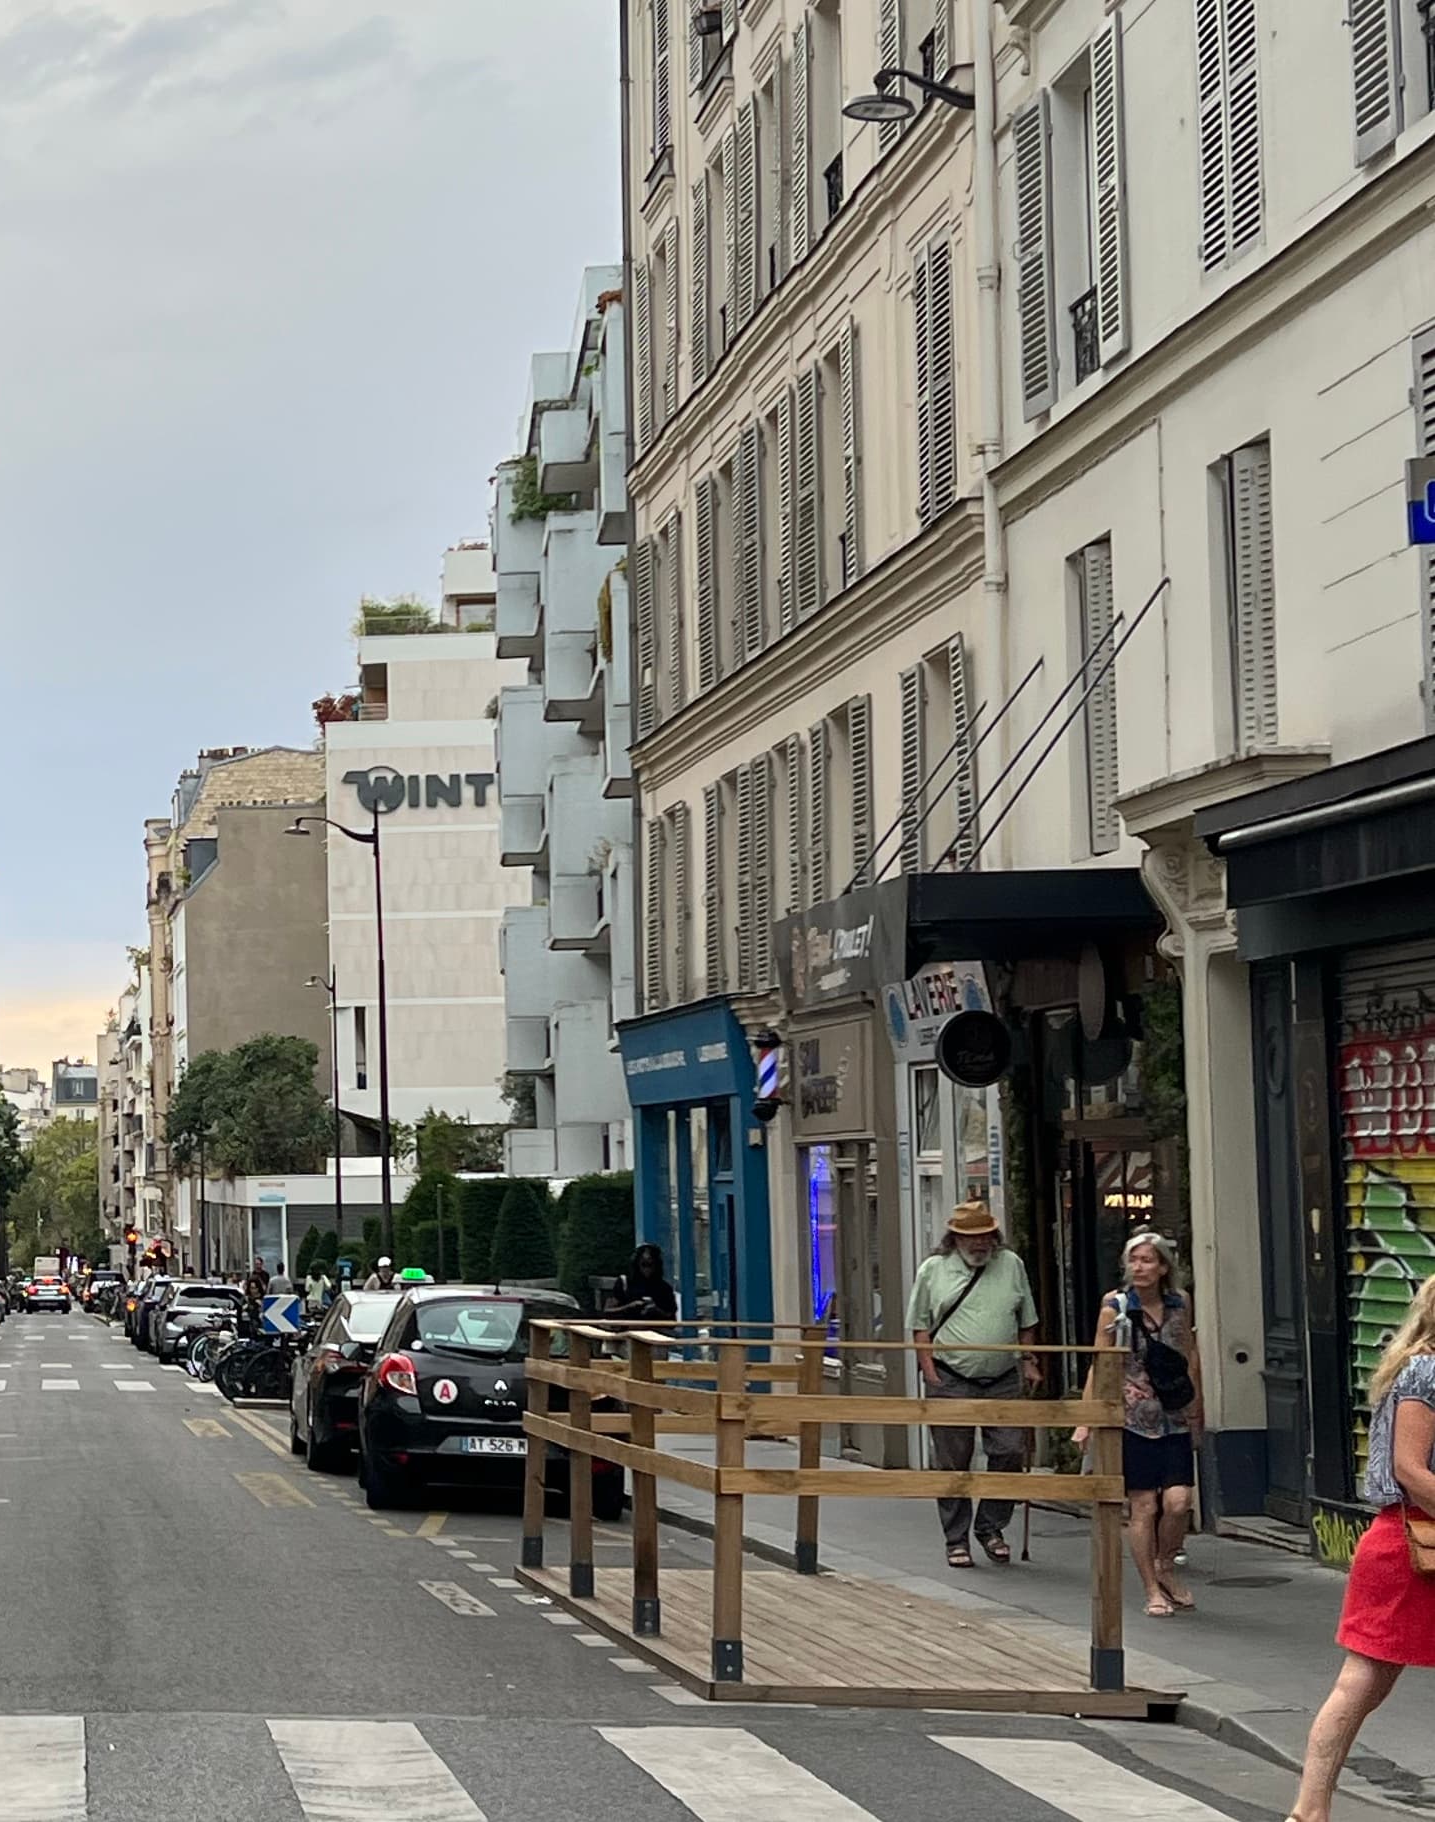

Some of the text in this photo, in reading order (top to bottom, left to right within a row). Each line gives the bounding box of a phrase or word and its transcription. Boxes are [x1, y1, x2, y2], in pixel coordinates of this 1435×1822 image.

[341, 766, 501, 814] WINT
[902, 971, 963, 1020] LAVERIE
[439, 1383, 451, 1400] A
[490, 1438, 513, 1452] 526
